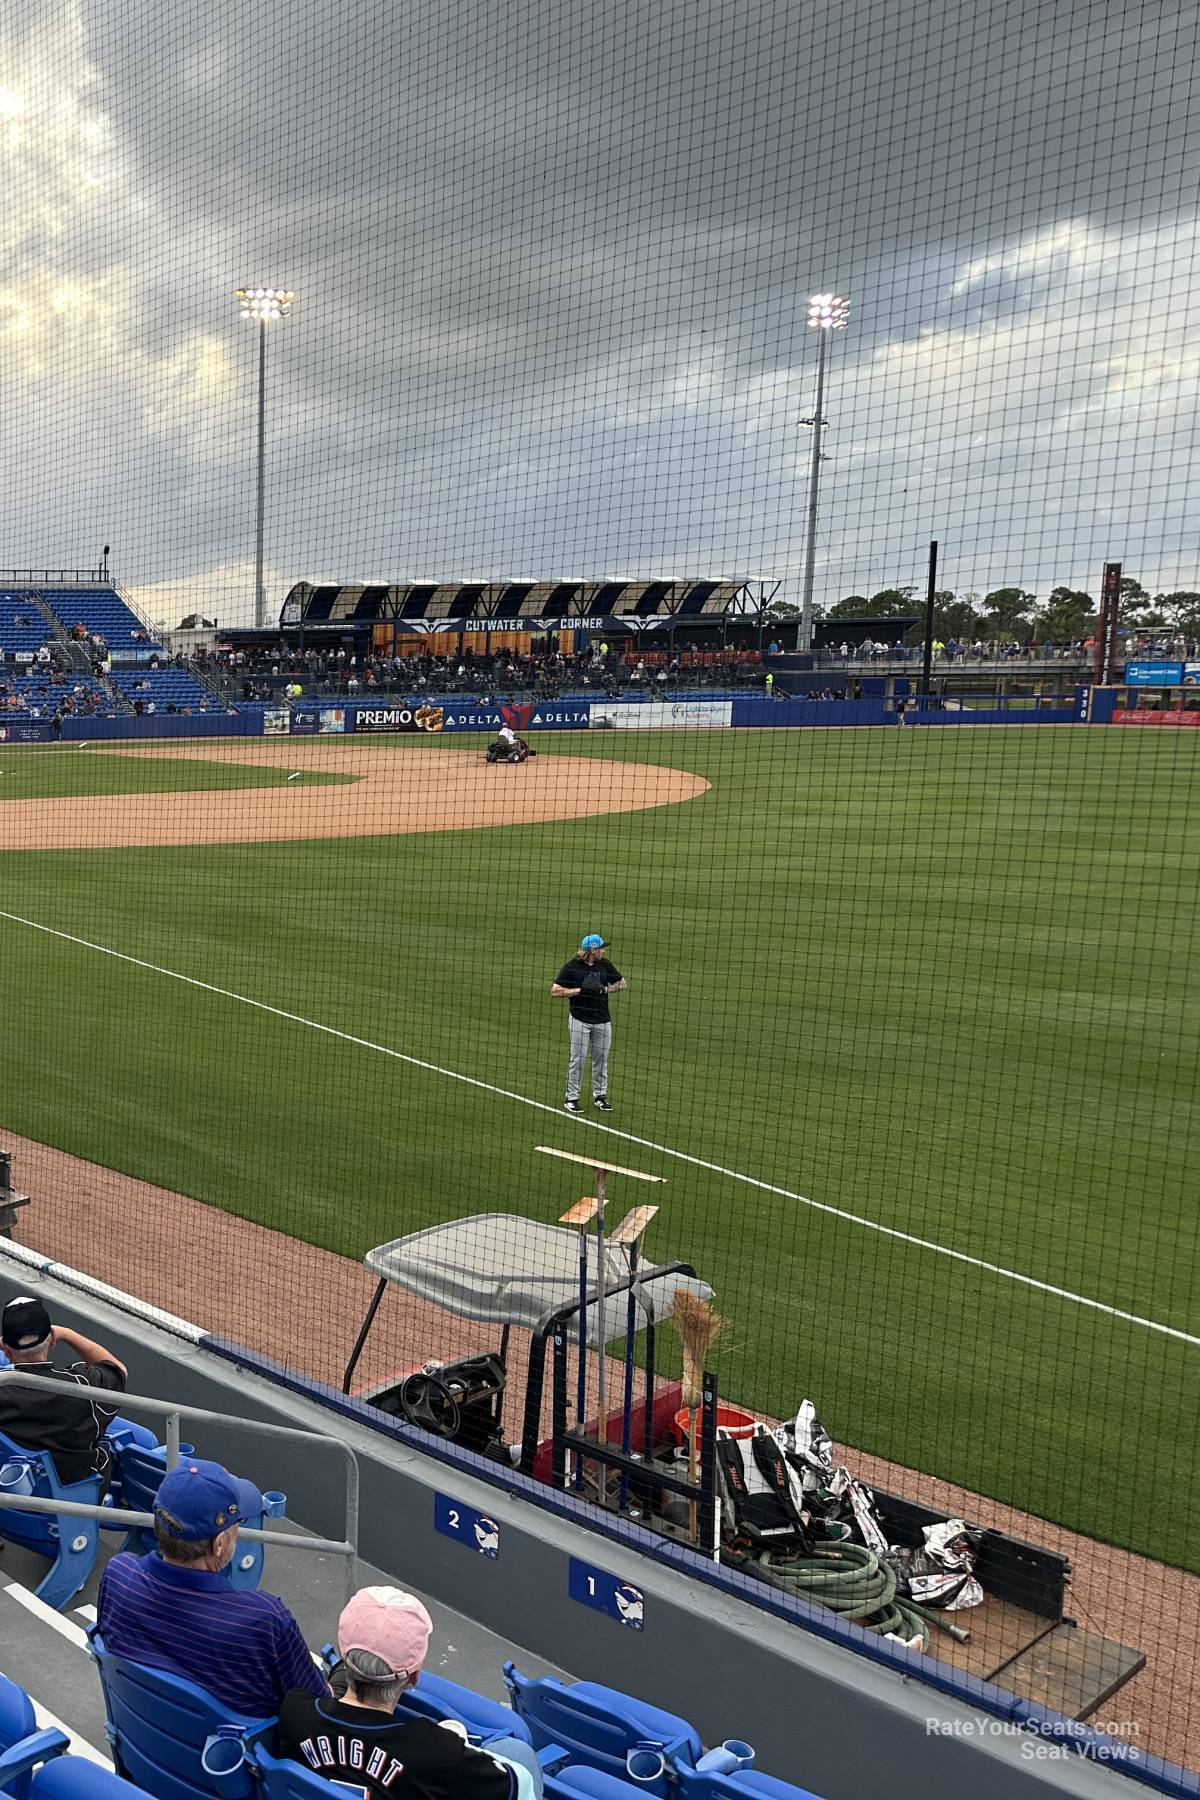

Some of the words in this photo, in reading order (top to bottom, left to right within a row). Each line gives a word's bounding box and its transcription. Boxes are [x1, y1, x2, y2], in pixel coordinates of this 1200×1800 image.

[465, 619, 524, 631] CUTWATER
[560, 617, 603, 630] CORNER
[1080, 689, 1089, 718] 330
[356, 709, 412, 725] PREMIO
[459, 714, 501, 725] DELTA
[546, 712, 589, 723] DELTA
[727, 1465, 744, 1491] STIHL
[773, 1461, 785, 1486] STIHL
[448, 1510, 460, 1529] 2
[587, 1576, 596, 1596] 1
[300, 1736, 404, 1789] WRIGHT
